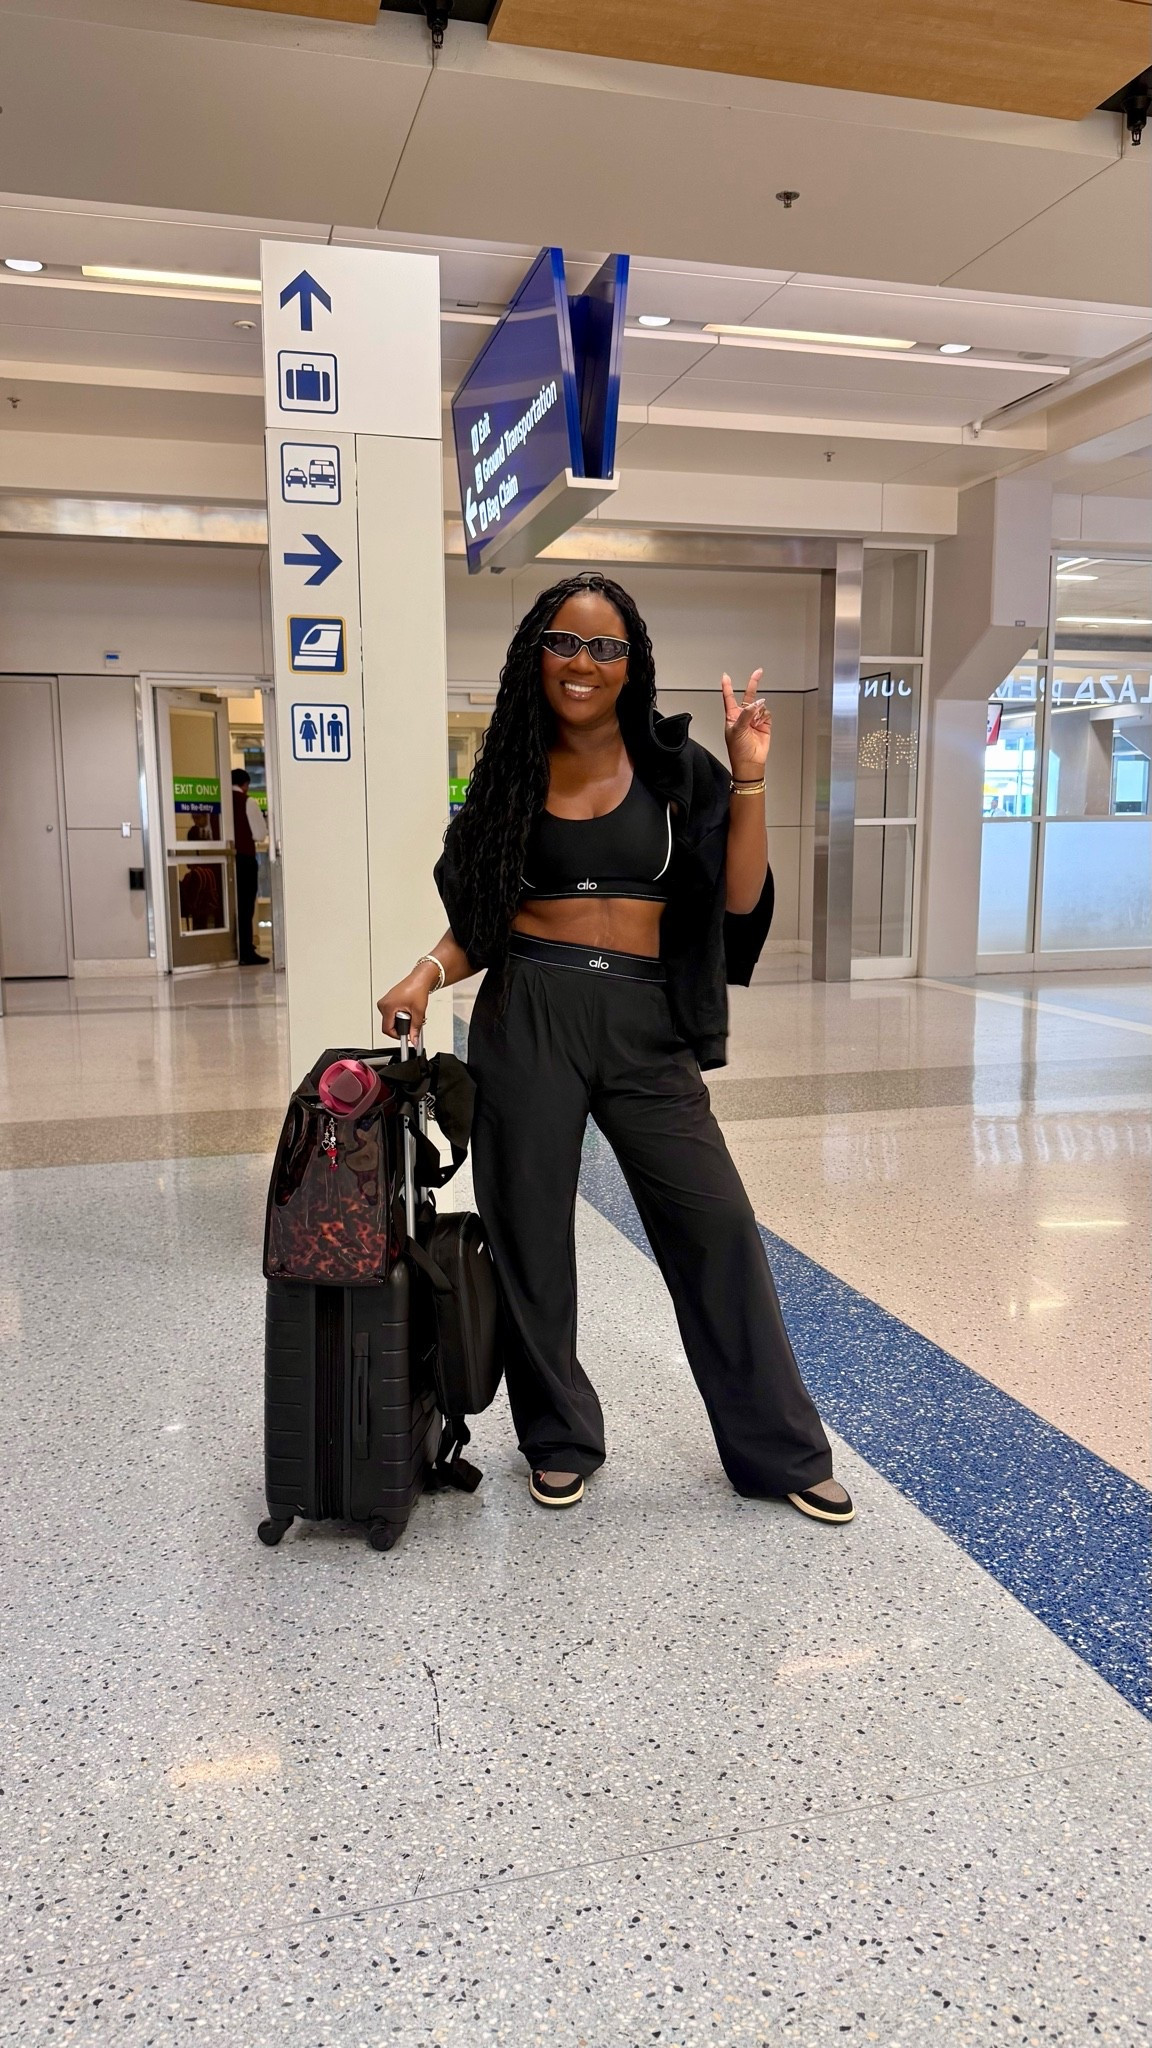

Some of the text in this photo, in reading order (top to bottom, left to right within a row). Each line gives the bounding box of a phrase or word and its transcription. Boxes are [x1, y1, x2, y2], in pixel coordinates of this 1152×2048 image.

[478, 412, 491, 445] Exit
[482, 380, 557, 482] Ground Transportation
[486, 474, 519, 522] Bag Claim
[174, 783, 219, 796] EXIT ONLY
[180, 803, 214, 813] No Re-Entry
[577, 878, 597, 890] alo
[589, 956, 610, 970] alo
